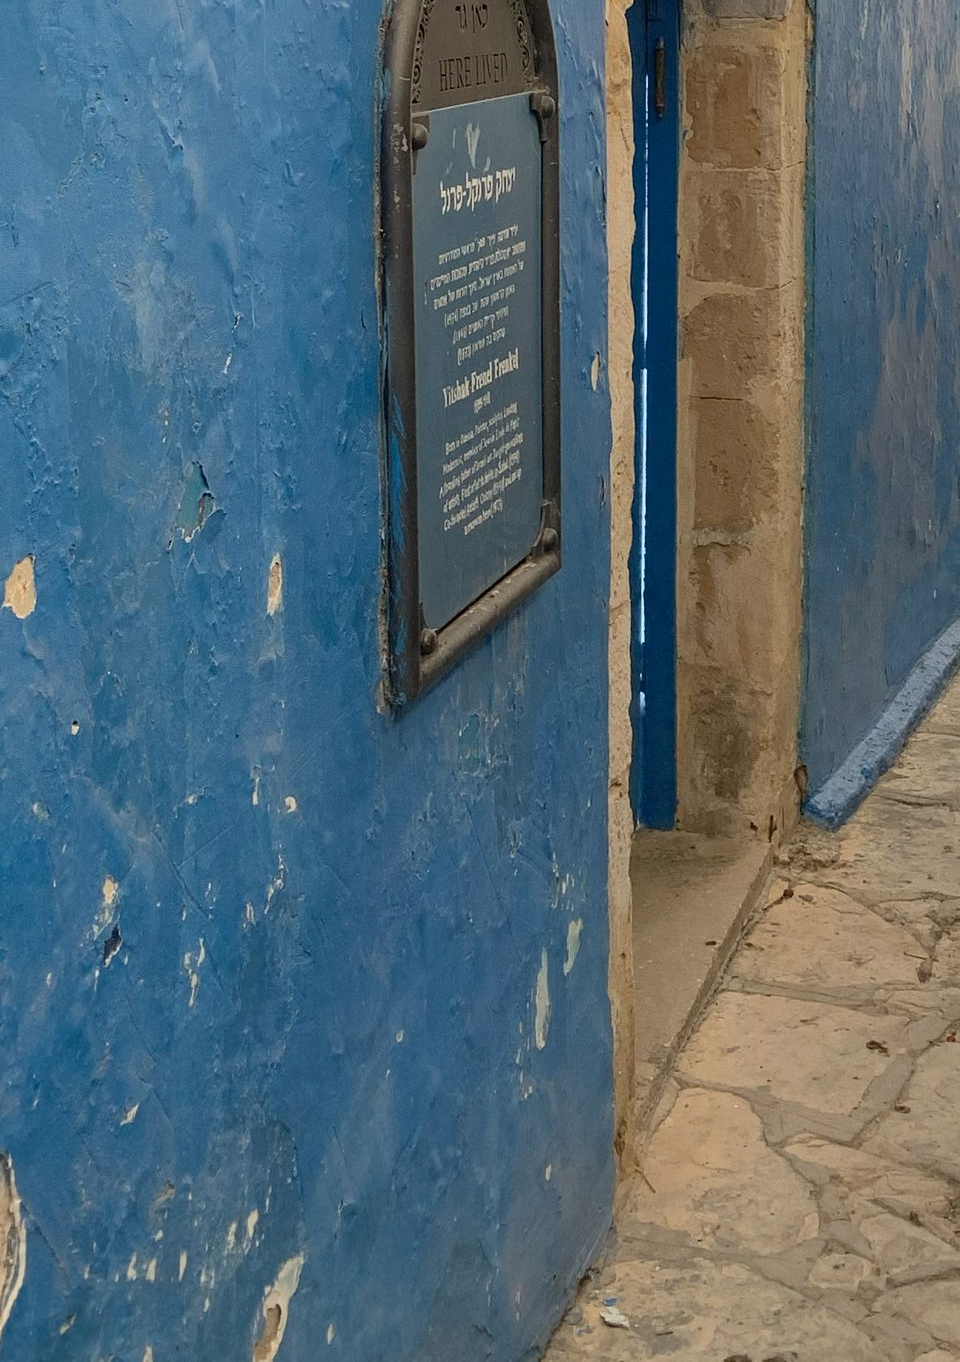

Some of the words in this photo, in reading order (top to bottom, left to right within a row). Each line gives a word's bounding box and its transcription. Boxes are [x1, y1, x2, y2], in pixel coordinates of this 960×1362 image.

[455, 3, 467, 28] גר
[471, 3, 488, 33] כאן
[439, 56, 471, 92] HERE
[475, 52, 508, 85] LIVED
[495, 167, 516, 204] יצחק
[494, 347, 519, 379] Frenkel
